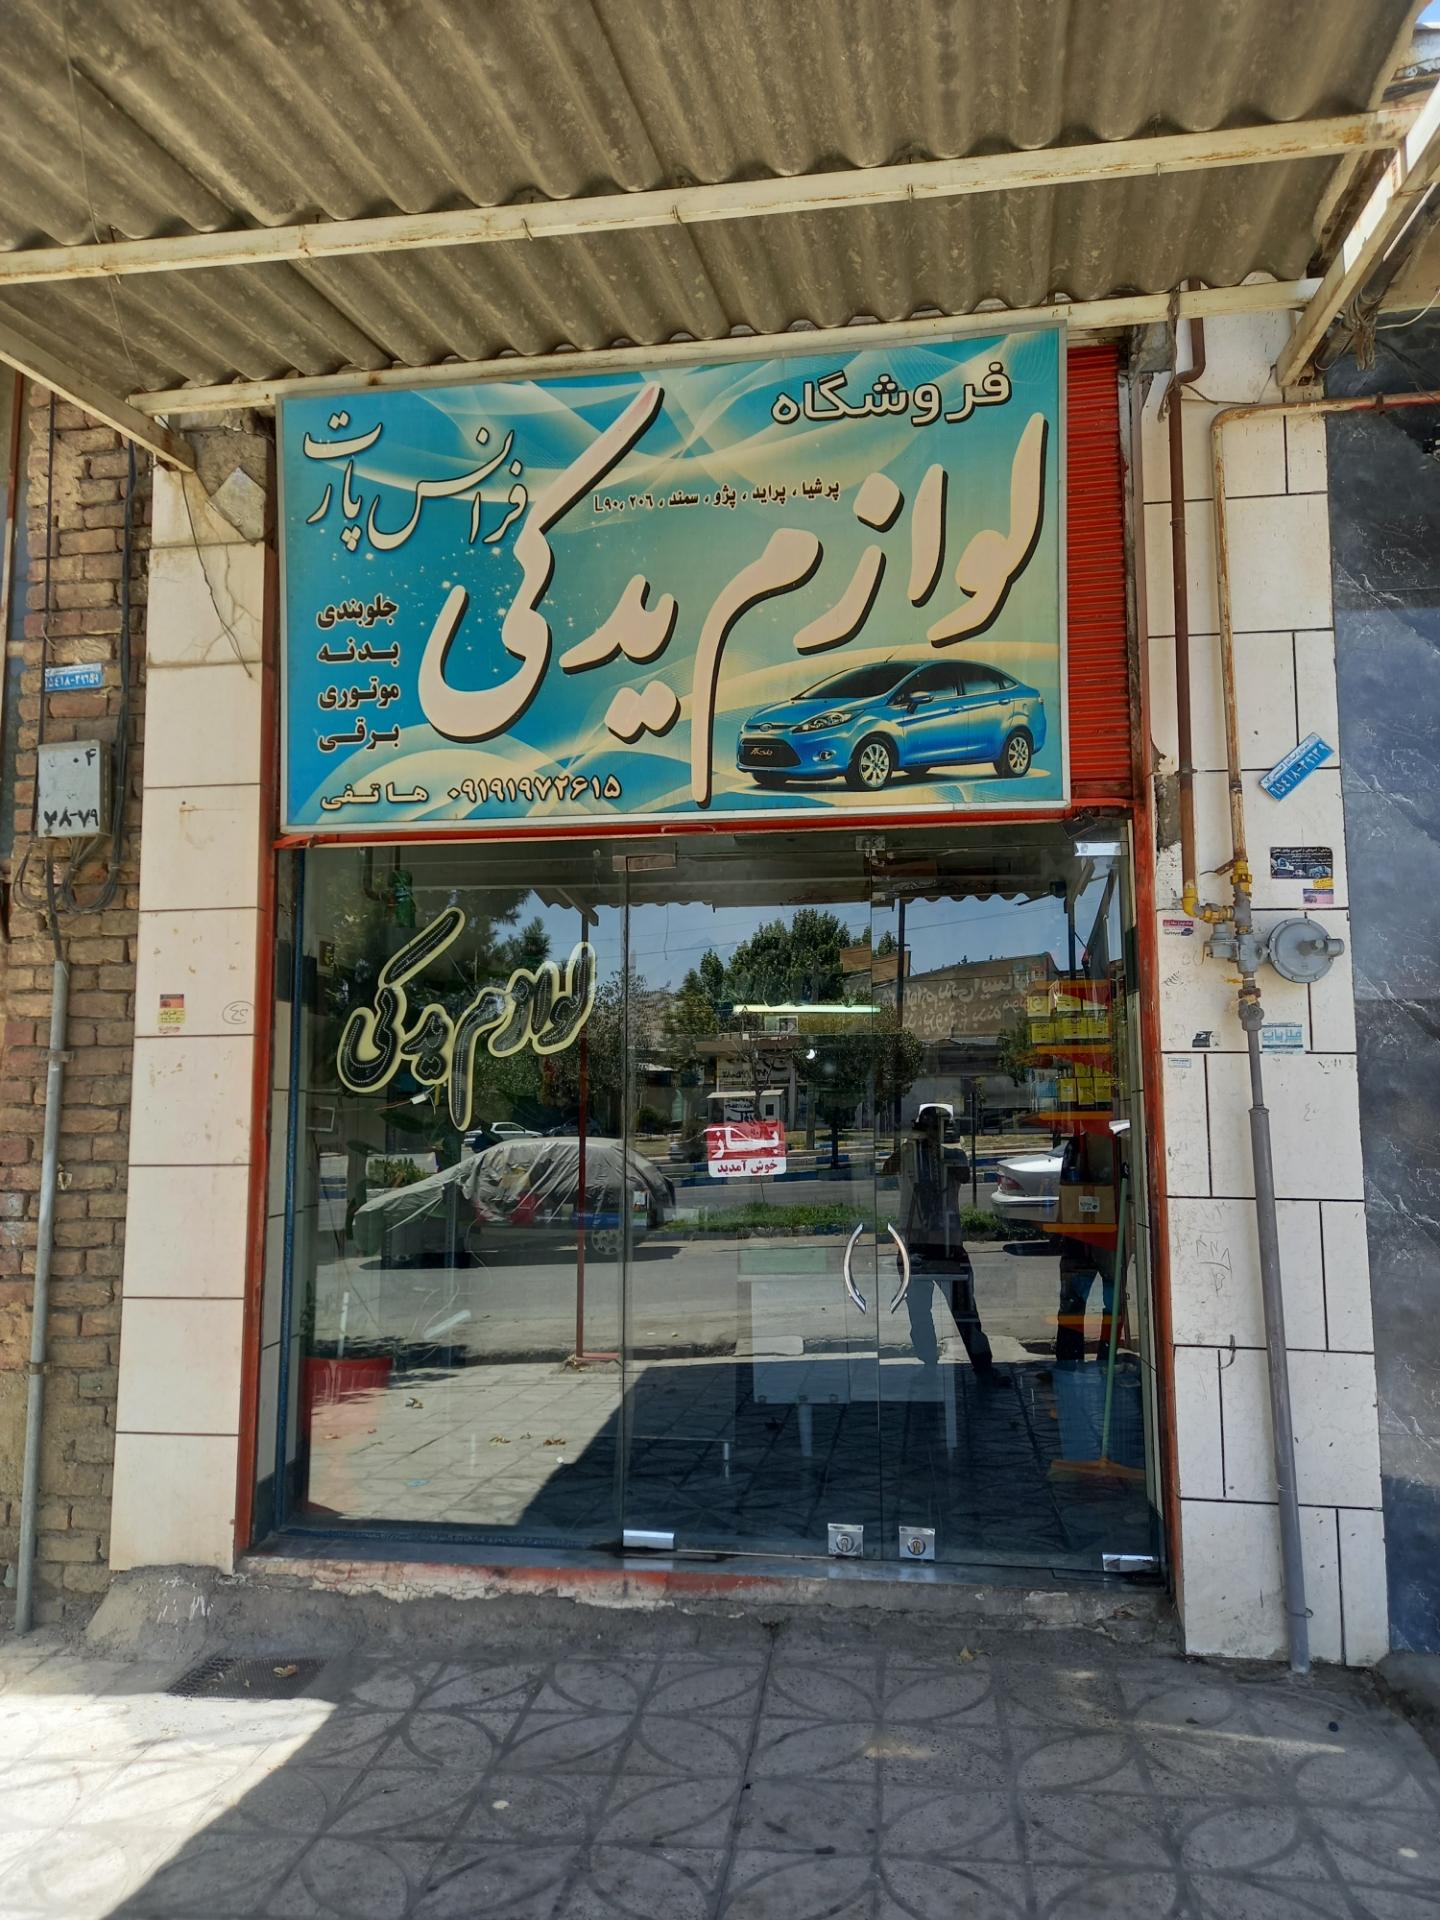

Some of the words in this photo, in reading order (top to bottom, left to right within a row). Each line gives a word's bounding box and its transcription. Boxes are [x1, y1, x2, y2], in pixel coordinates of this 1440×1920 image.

[771, 361, 1014, 427] فروشگاه
[418, 380, 681, 744] یدکی
[316, 593, 399, 630] جلوبندی
[692, 411, 1050, 808] لوازم
[317, 636, 401, 667] بدنه
[318, 676, 401, 709] موتوری
[317, 715, 401, 753] برقی
[447, 773, 623, 804] ۰۹۱۹۱۹۷۲۶۱۵
[337, 907, 466, 1093] یدکی
[449, 941, 596, 1132] لوازم
[711, 1126, 780, 1158] باز
[717, 1160, 748, 1175] آمدید
[750, 1160, 778, 1174] خوش
